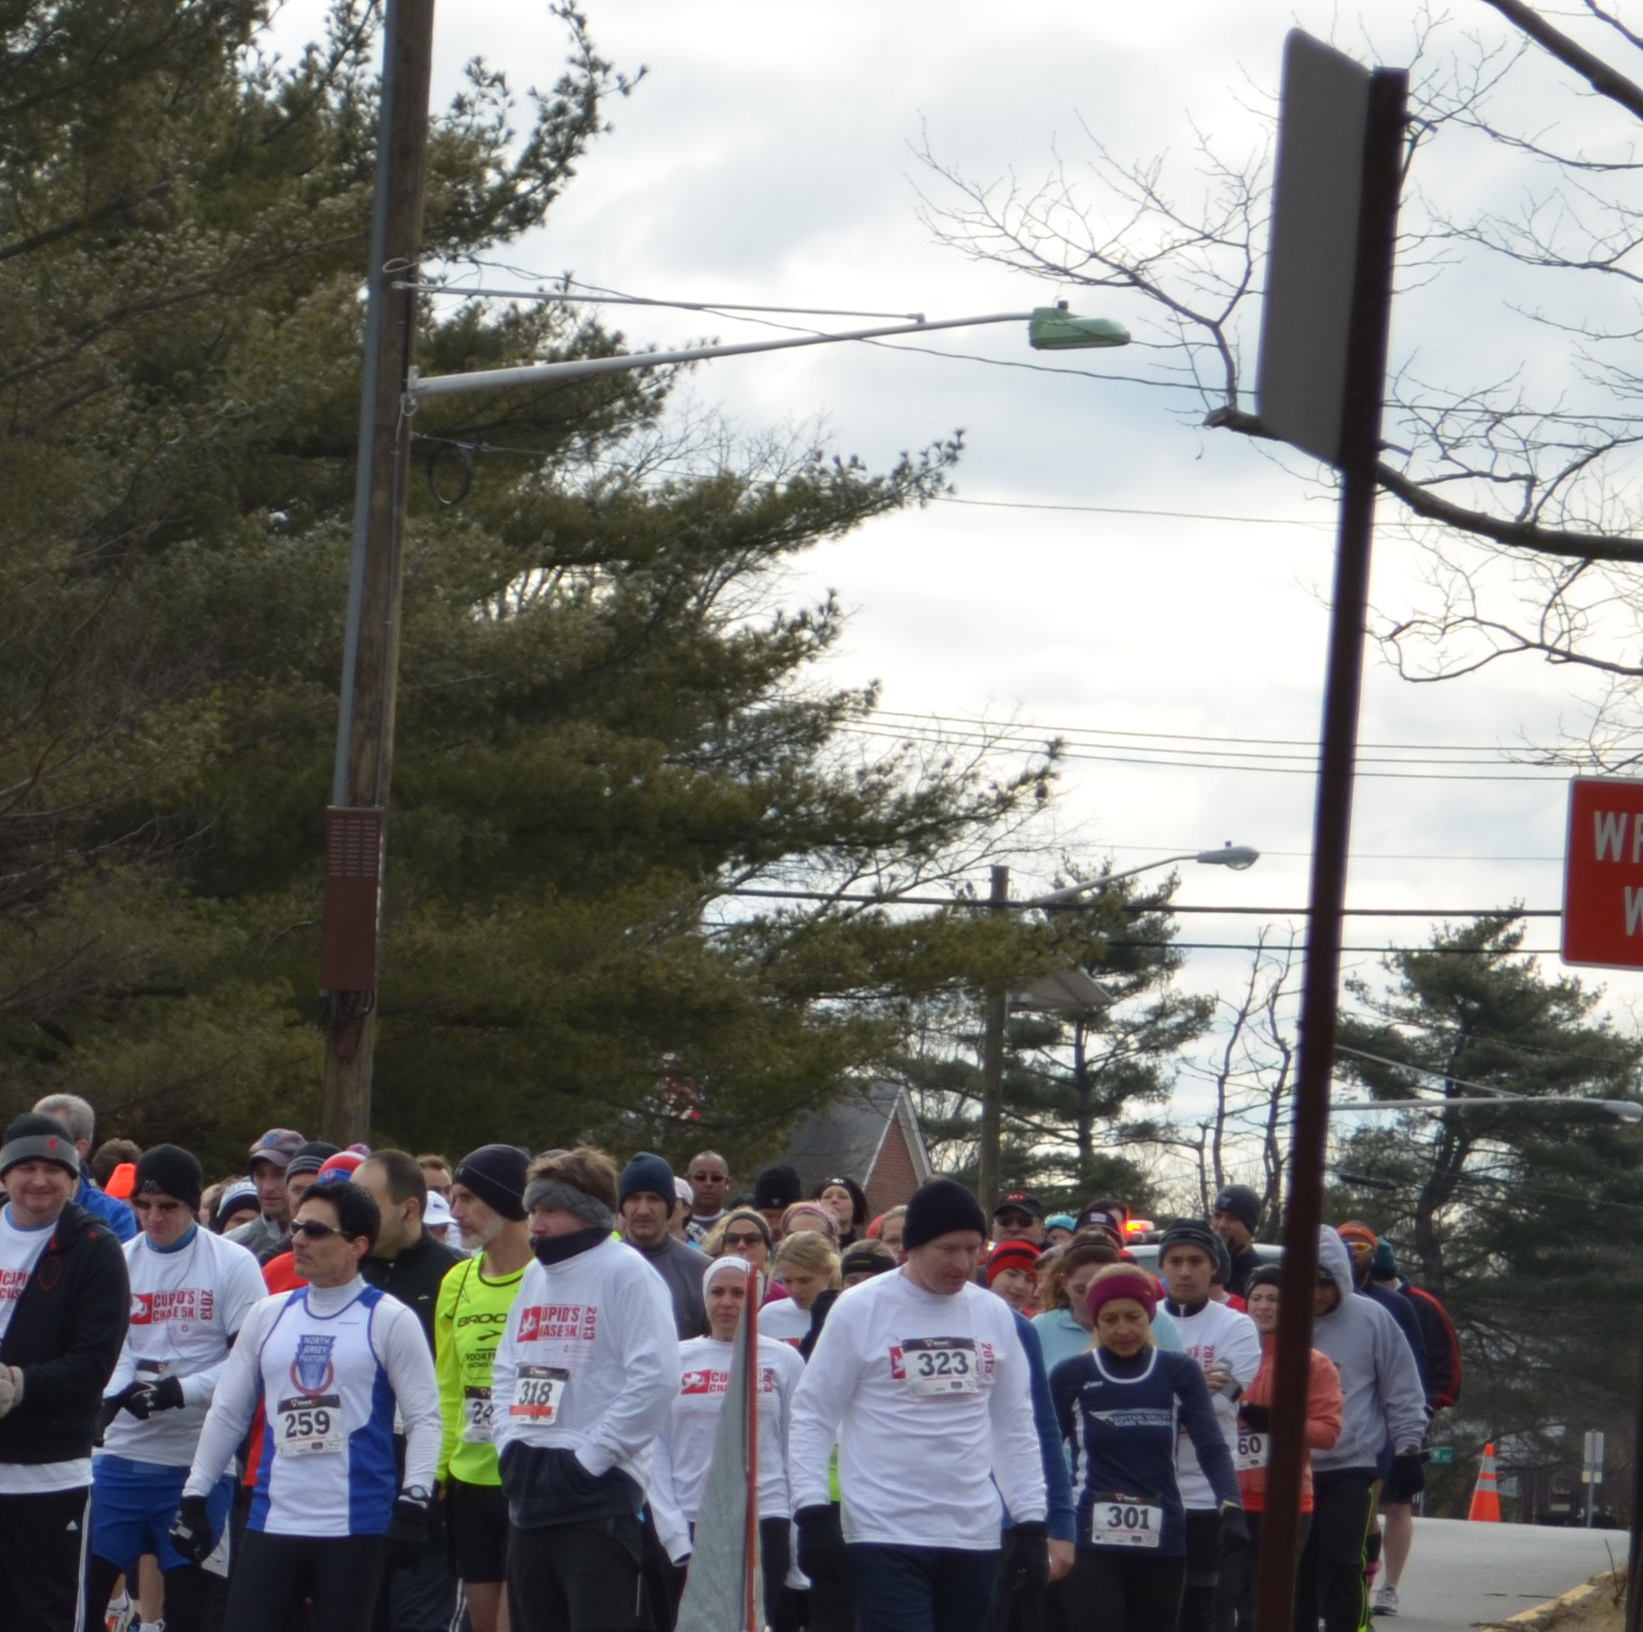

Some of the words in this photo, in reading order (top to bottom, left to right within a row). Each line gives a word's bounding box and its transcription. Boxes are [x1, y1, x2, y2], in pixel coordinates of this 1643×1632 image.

[200, 1290, 214, 1321] 2013
[583, 1307, 597, 1341] 2013
[918, 1351, 969, 1377] 323
[518, 1380, 553, 1405] 318
[285, 1409, 331, 1439] 259
[1107, 1506, 1150, 1531] 301
